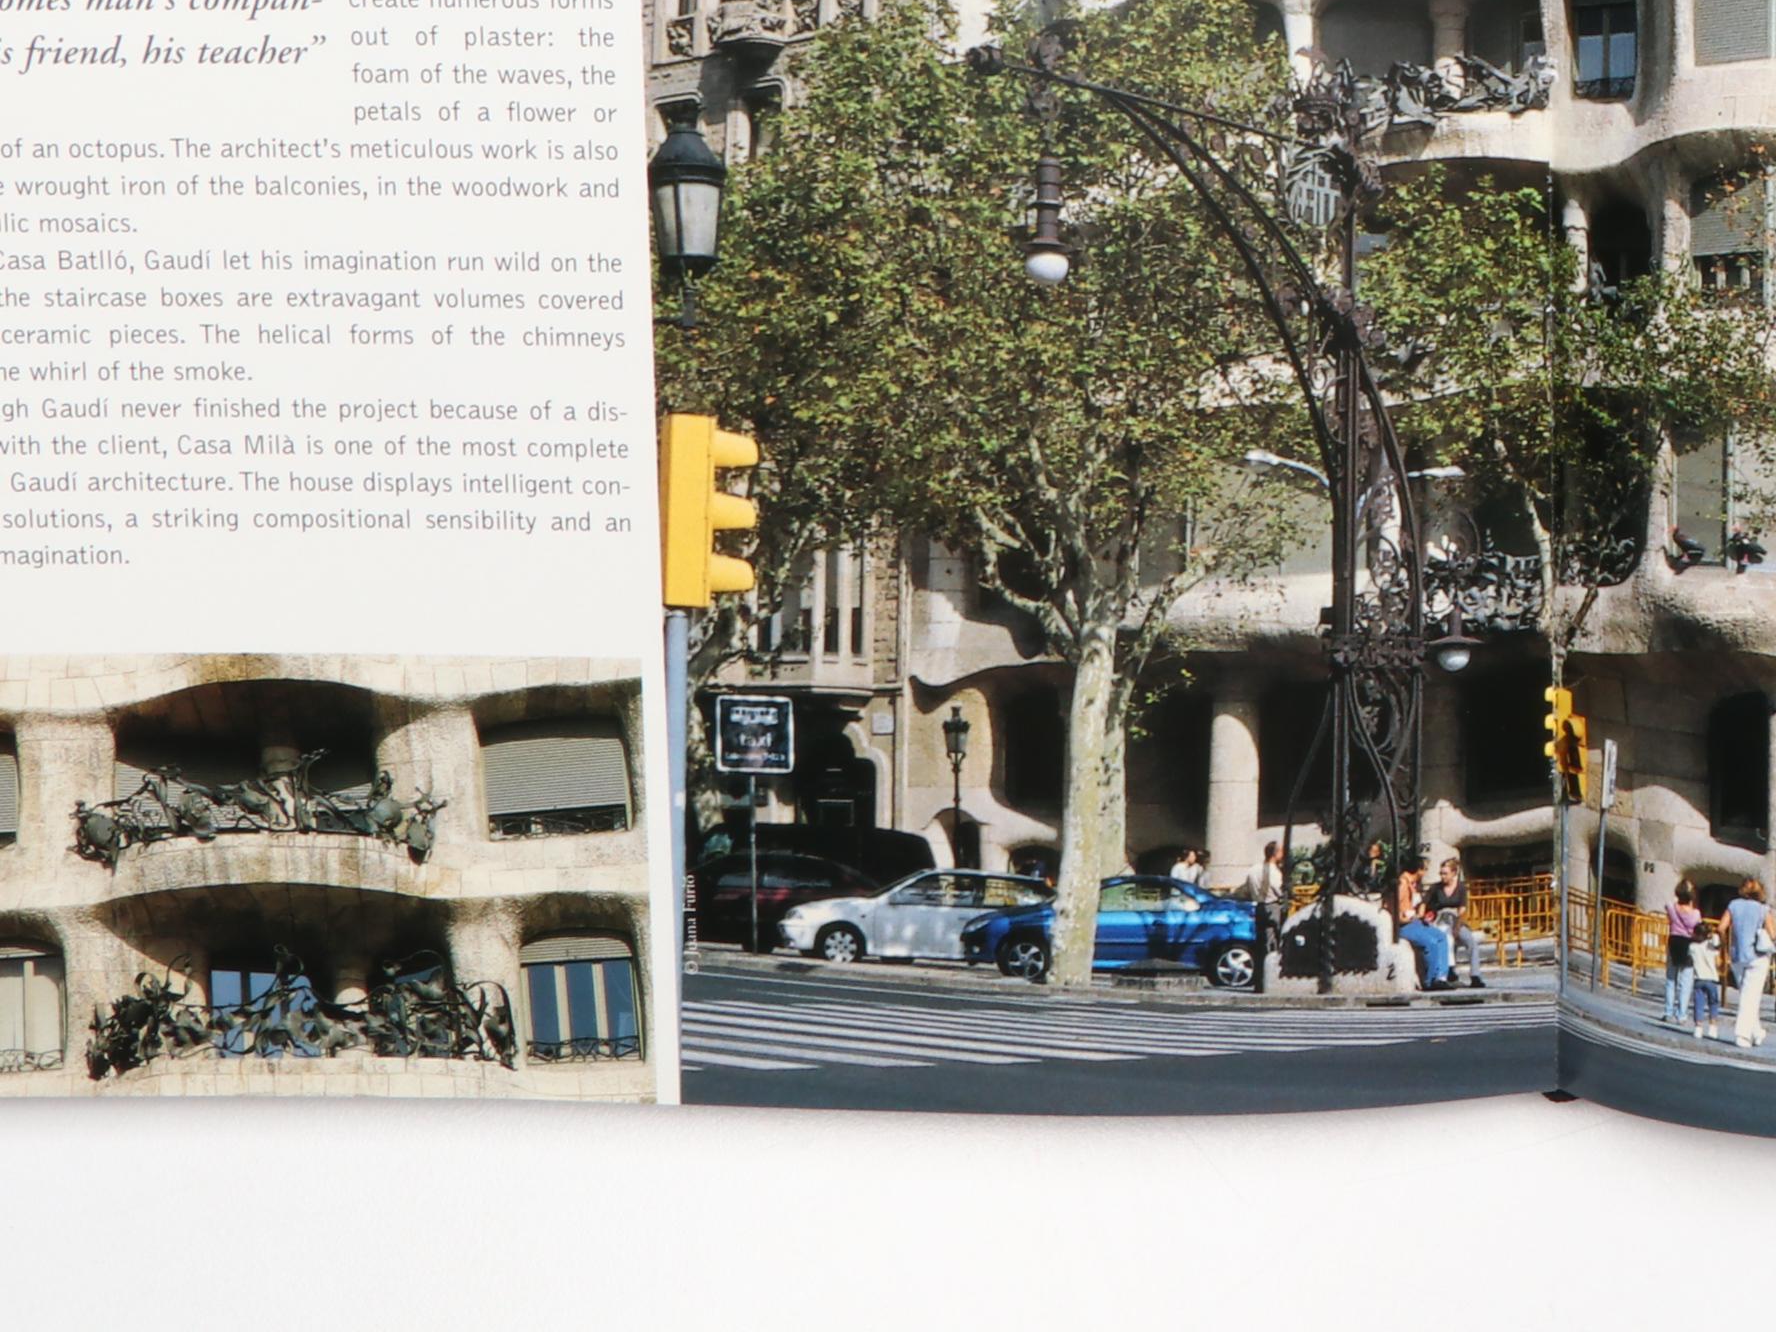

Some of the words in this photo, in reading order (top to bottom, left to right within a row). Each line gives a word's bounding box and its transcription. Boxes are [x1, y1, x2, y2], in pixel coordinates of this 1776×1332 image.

[17, 33, 127, 76] friend,
[141, 33, 186, 65] his
[354, 100, 422, 126] petals
[438, 100, 461, 122] of
[477, 106, 491, 122] a
[506, 100, 577, 123] flower
[593, 107, 618, 123] or
[0, 137, 23, 159] of
[32, 142, 59, 159] an
[68, 139, 165, 163] octopus.
[169, 137, 211, 159] The
[350, 138, 474, 160] meticulous
[481, 139, 537, 160] work
[547, 139, 565, 160] is
[573, 139, 619, 161] also
[39, 212, 138, 233] mosaics.
[1, 323, 92, 345] ceramic
[109, 323, 186, 349] pieces.
[199, 323, 241, 345] The
[258, 323, 331, 345] helical
[349, 323, 414, 345] forms
[431, 324, 454, 346] of
[469, 325, 505, 346] the
[522, 325, 626, 352] chimneys
[10, 471, 77, 493] Gaudí
[87, 471, 234, 492] architecture.
[239, 470, 280, 492] The
[289, 471, 354, 492] house
[362, 471, 453, 497] displays
[462, 472, 574, 498] intelligent
[582, 479, 631, 496] con-
[2, 508, 113, 533] solutions,
[124, 512, 139, 528] a
[151, 507, 239, 532] striking
[252, 508, 411, 533] compositional
[425, 509, 537, 536] sensibility
[550, 510, 591, 532] and
[605, 516, 632, 533] an
